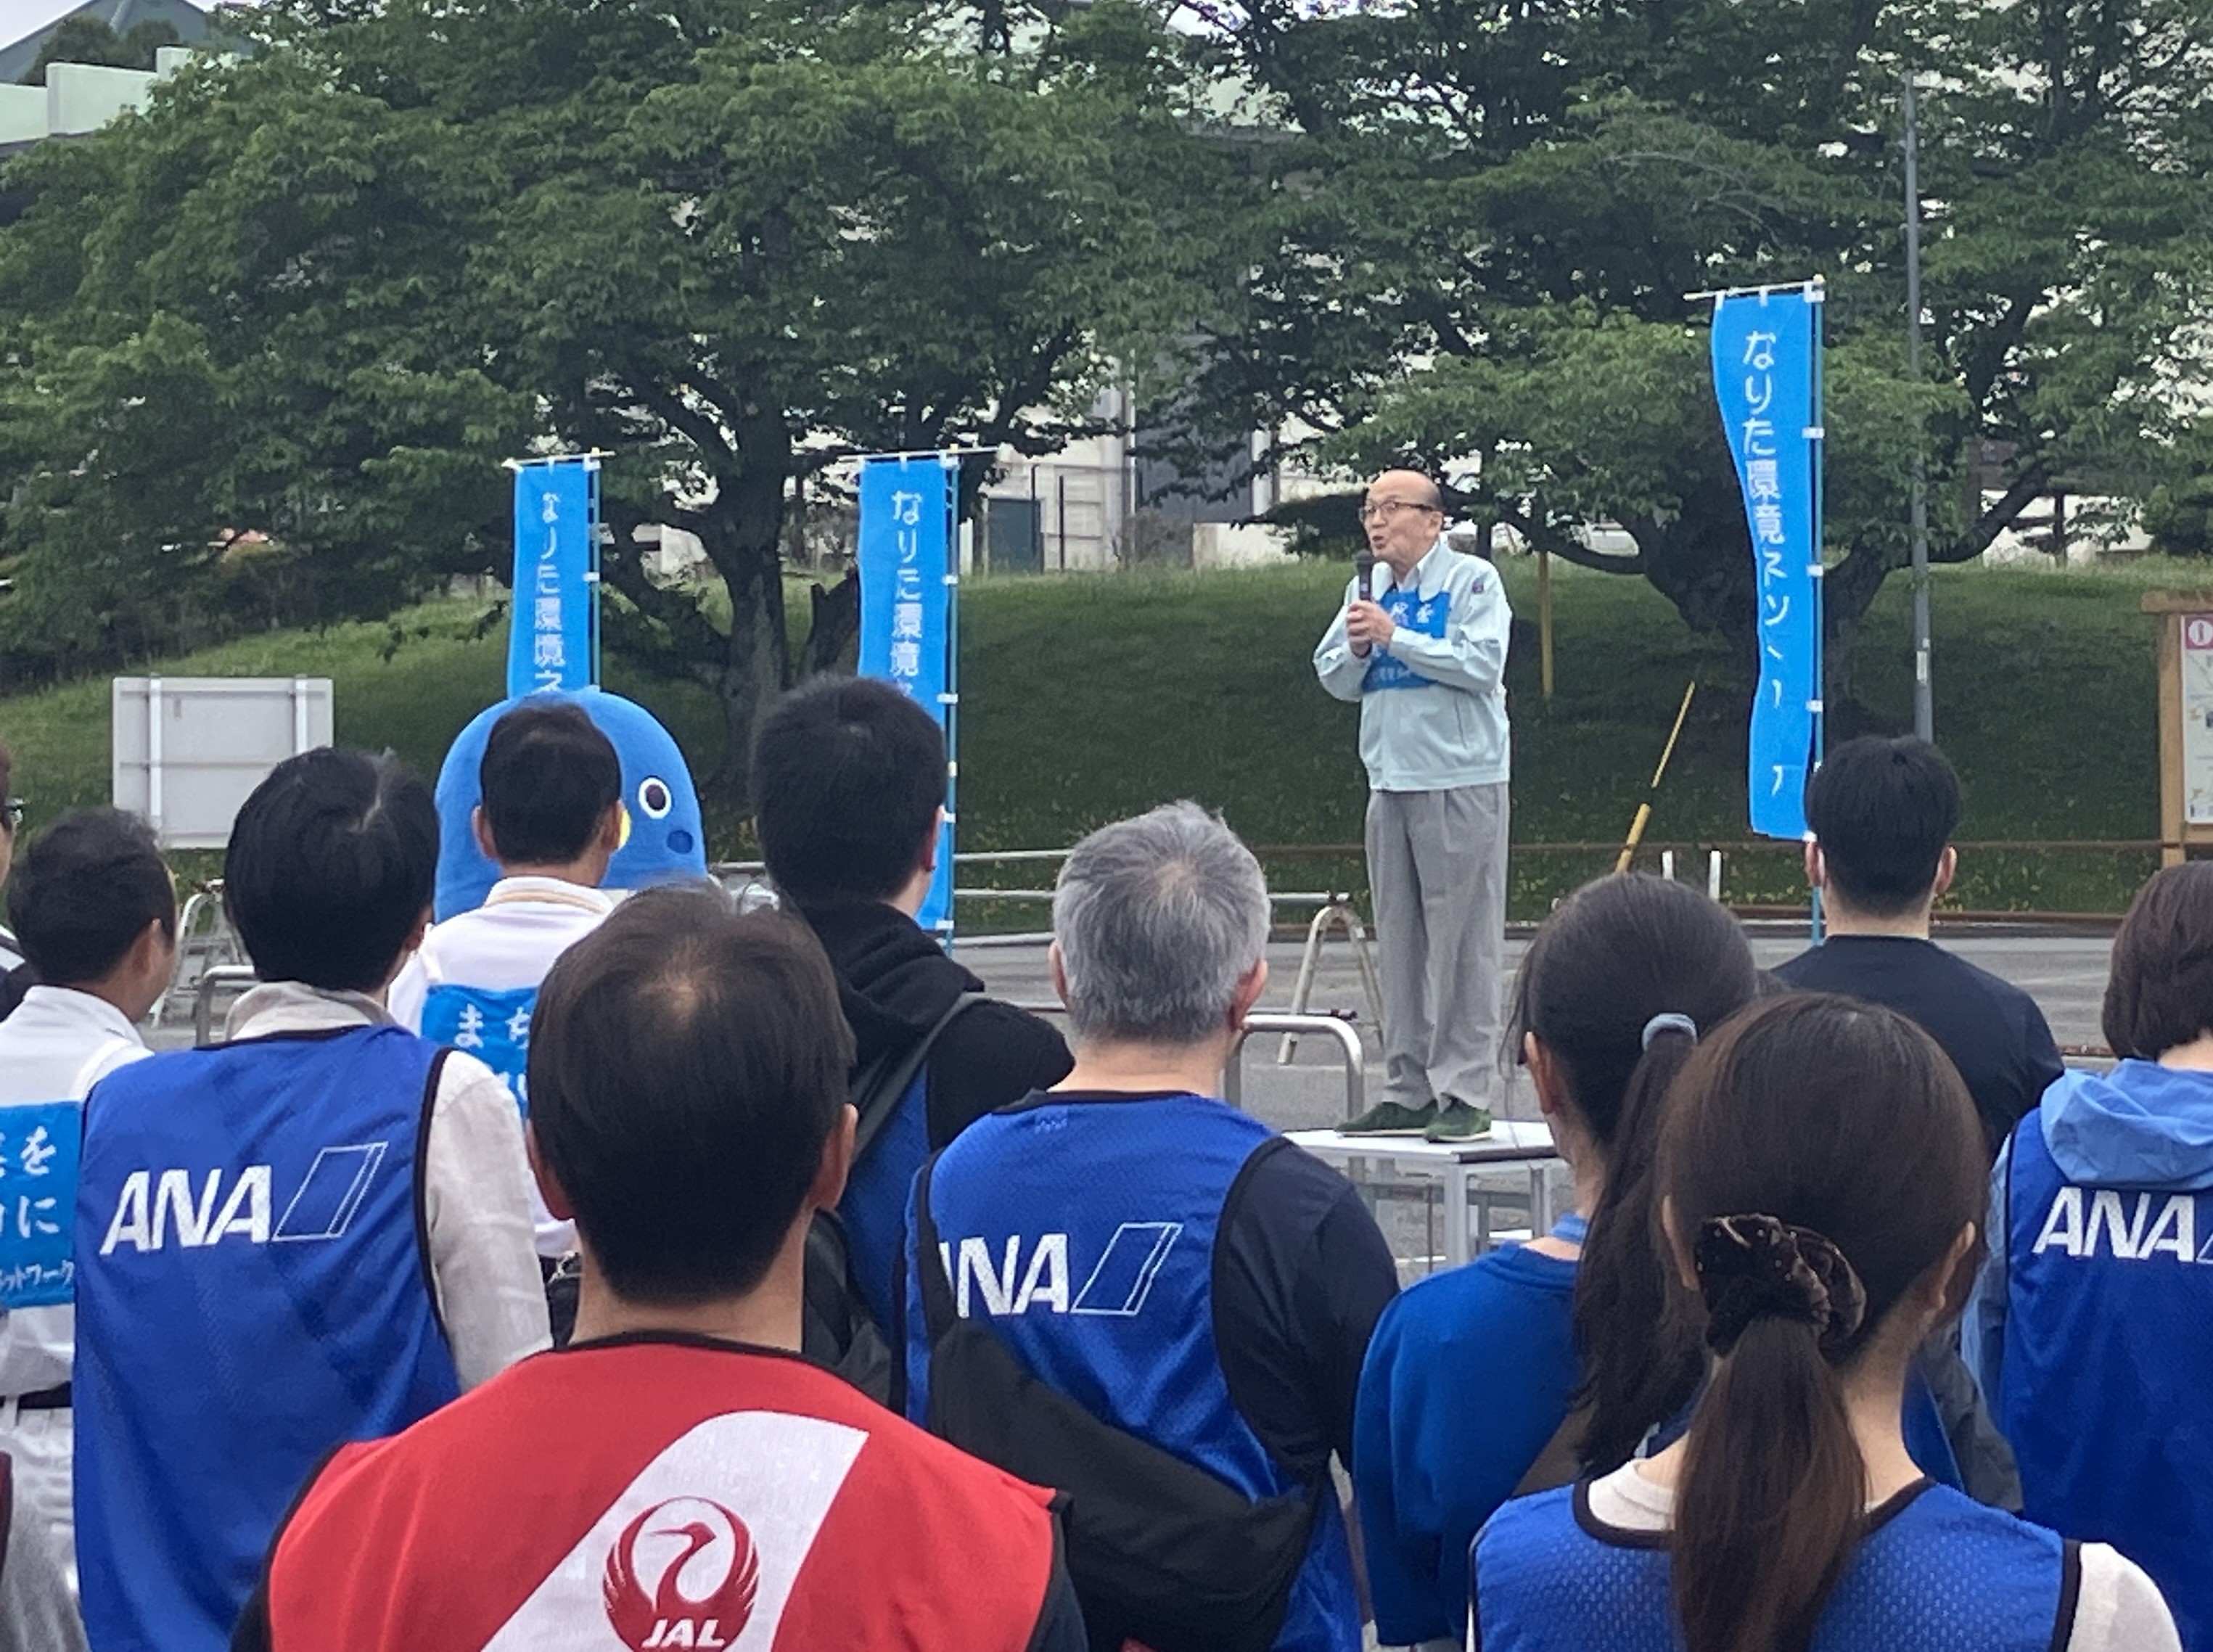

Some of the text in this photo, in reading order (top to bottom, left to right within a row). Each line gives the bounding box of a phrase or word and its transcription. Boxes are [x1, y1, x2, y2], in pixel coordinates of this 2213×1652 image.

[0, 1125, 57, 1178] を
[0, 1195, 60, 1239] に
[99, 1165, 272, 1255] ANA
[2032, 1186, 2195, 1262] ANA
[0, 1259, 74, 1291] ットワーク
[939, 1233, 1069, 1318] NA
[641, 1619, 726, 1648] JAL
